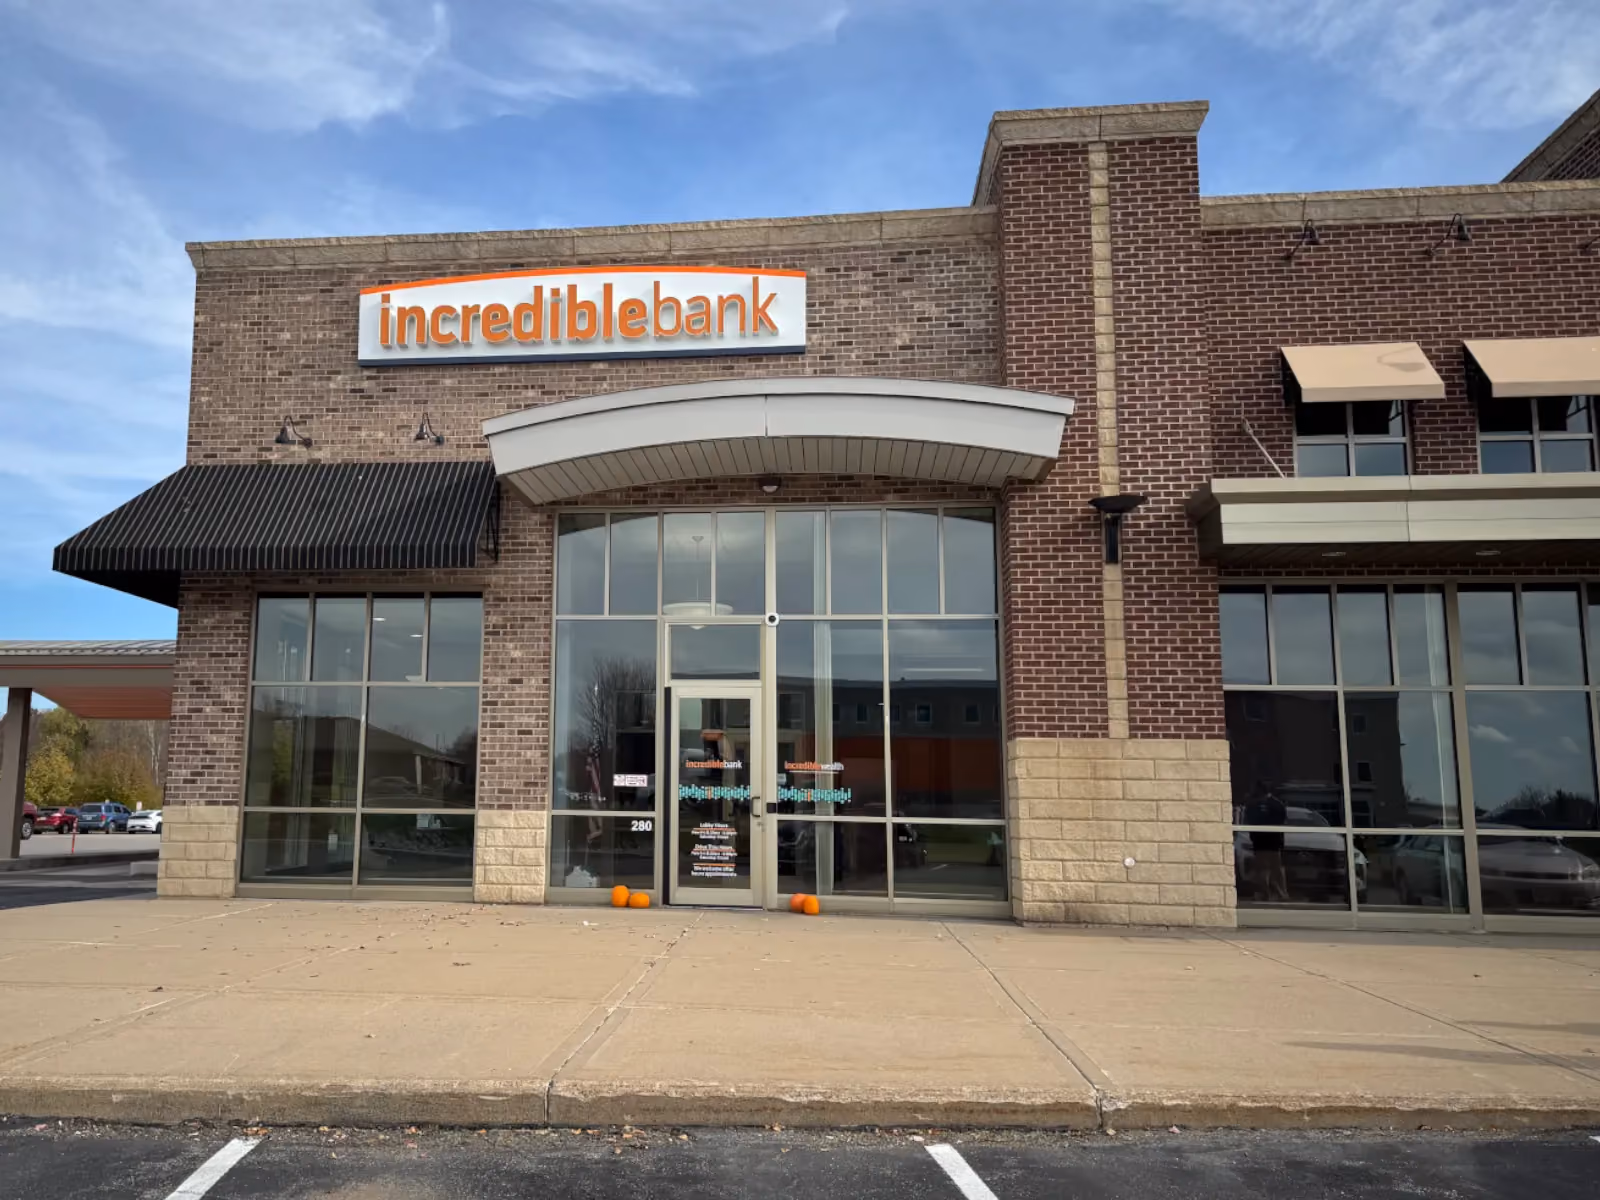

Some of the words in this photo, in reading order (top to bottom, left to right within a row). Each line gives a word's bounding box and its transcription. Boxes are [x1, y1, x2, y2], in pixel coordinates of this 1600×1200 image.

[379, 276, 778, 345] incrediblebank
[686, 760, 742, 769] incrediblebank
[631, 820, 653, 831] 280
